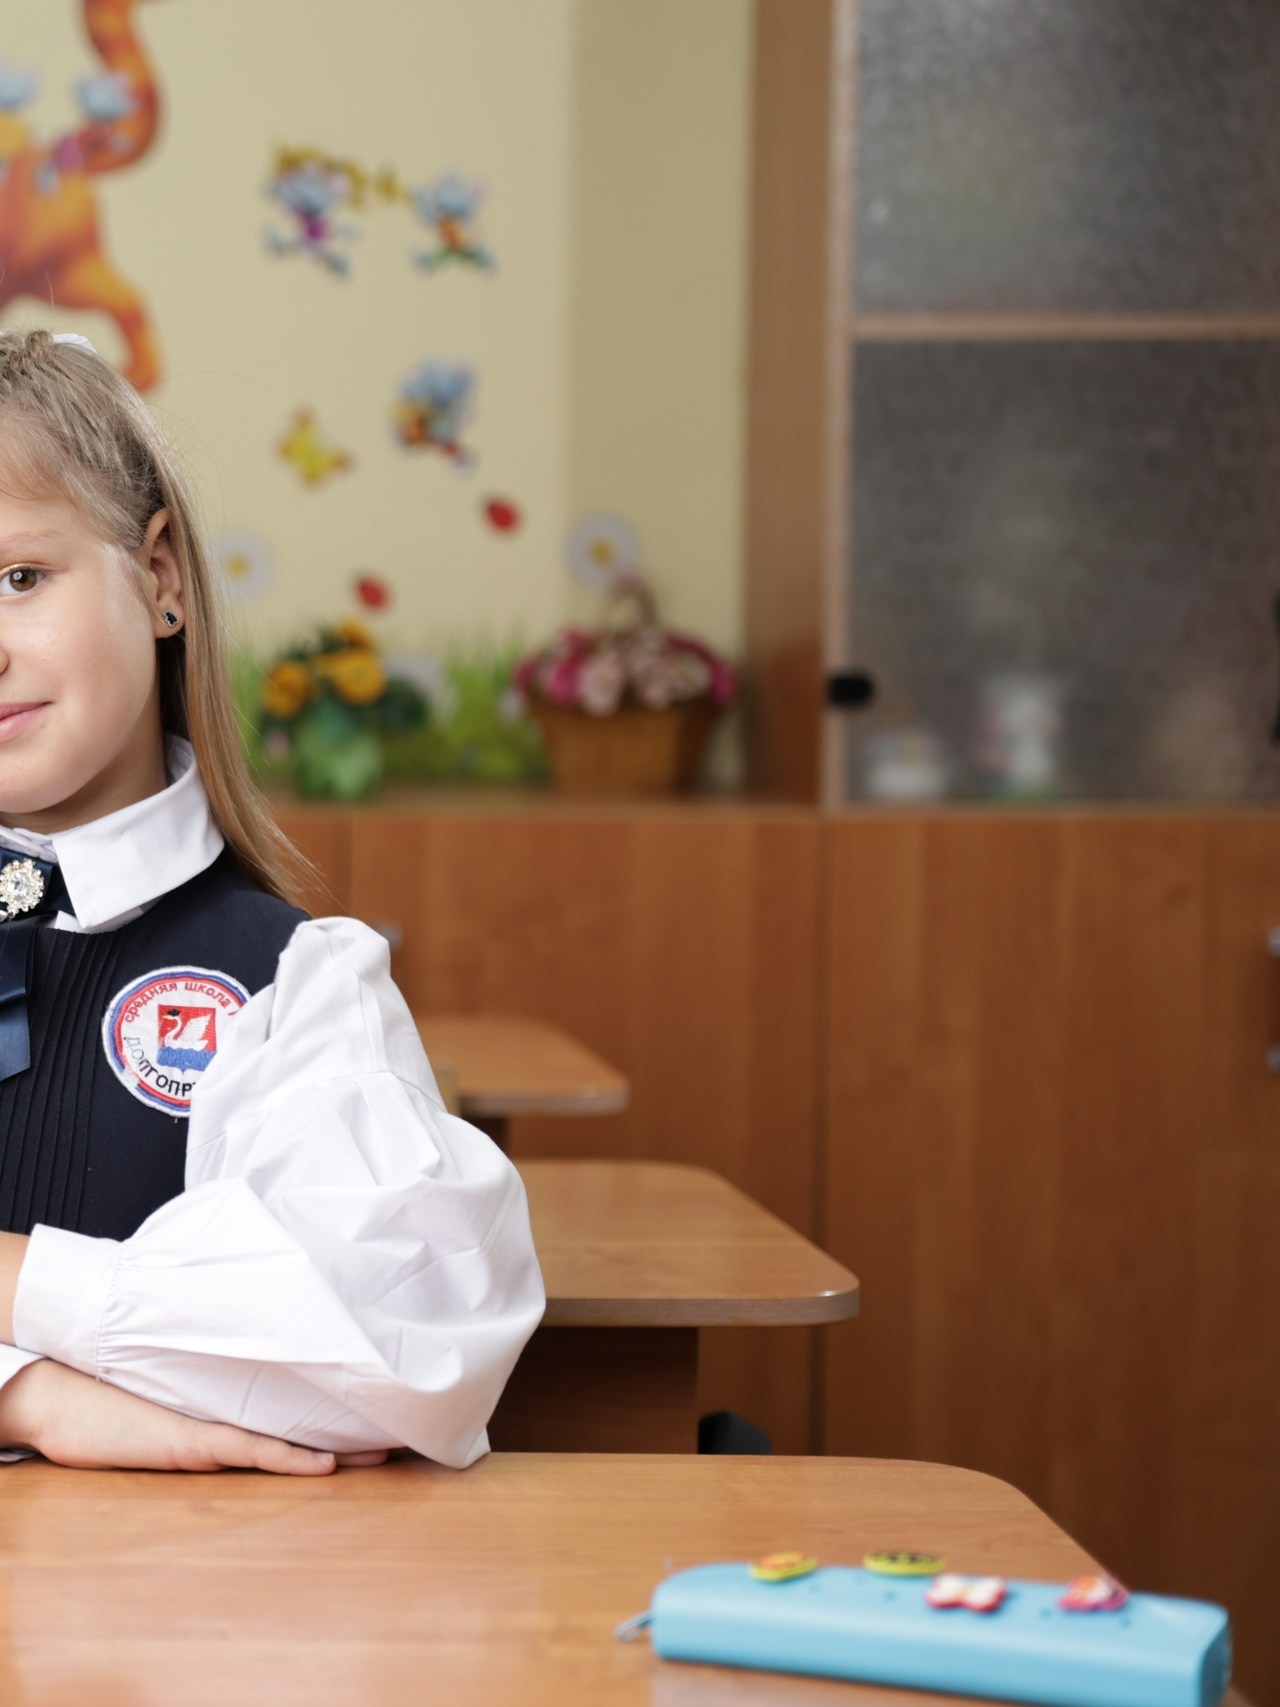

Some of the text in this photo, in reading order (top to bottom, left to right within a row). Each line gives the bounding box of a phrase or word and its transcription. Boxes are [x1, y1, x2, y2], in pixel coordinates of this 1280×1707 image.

[125, 982, 232, 1023] средняя школа
[123, 1036, 196, 1097] ДОЛГОПР
